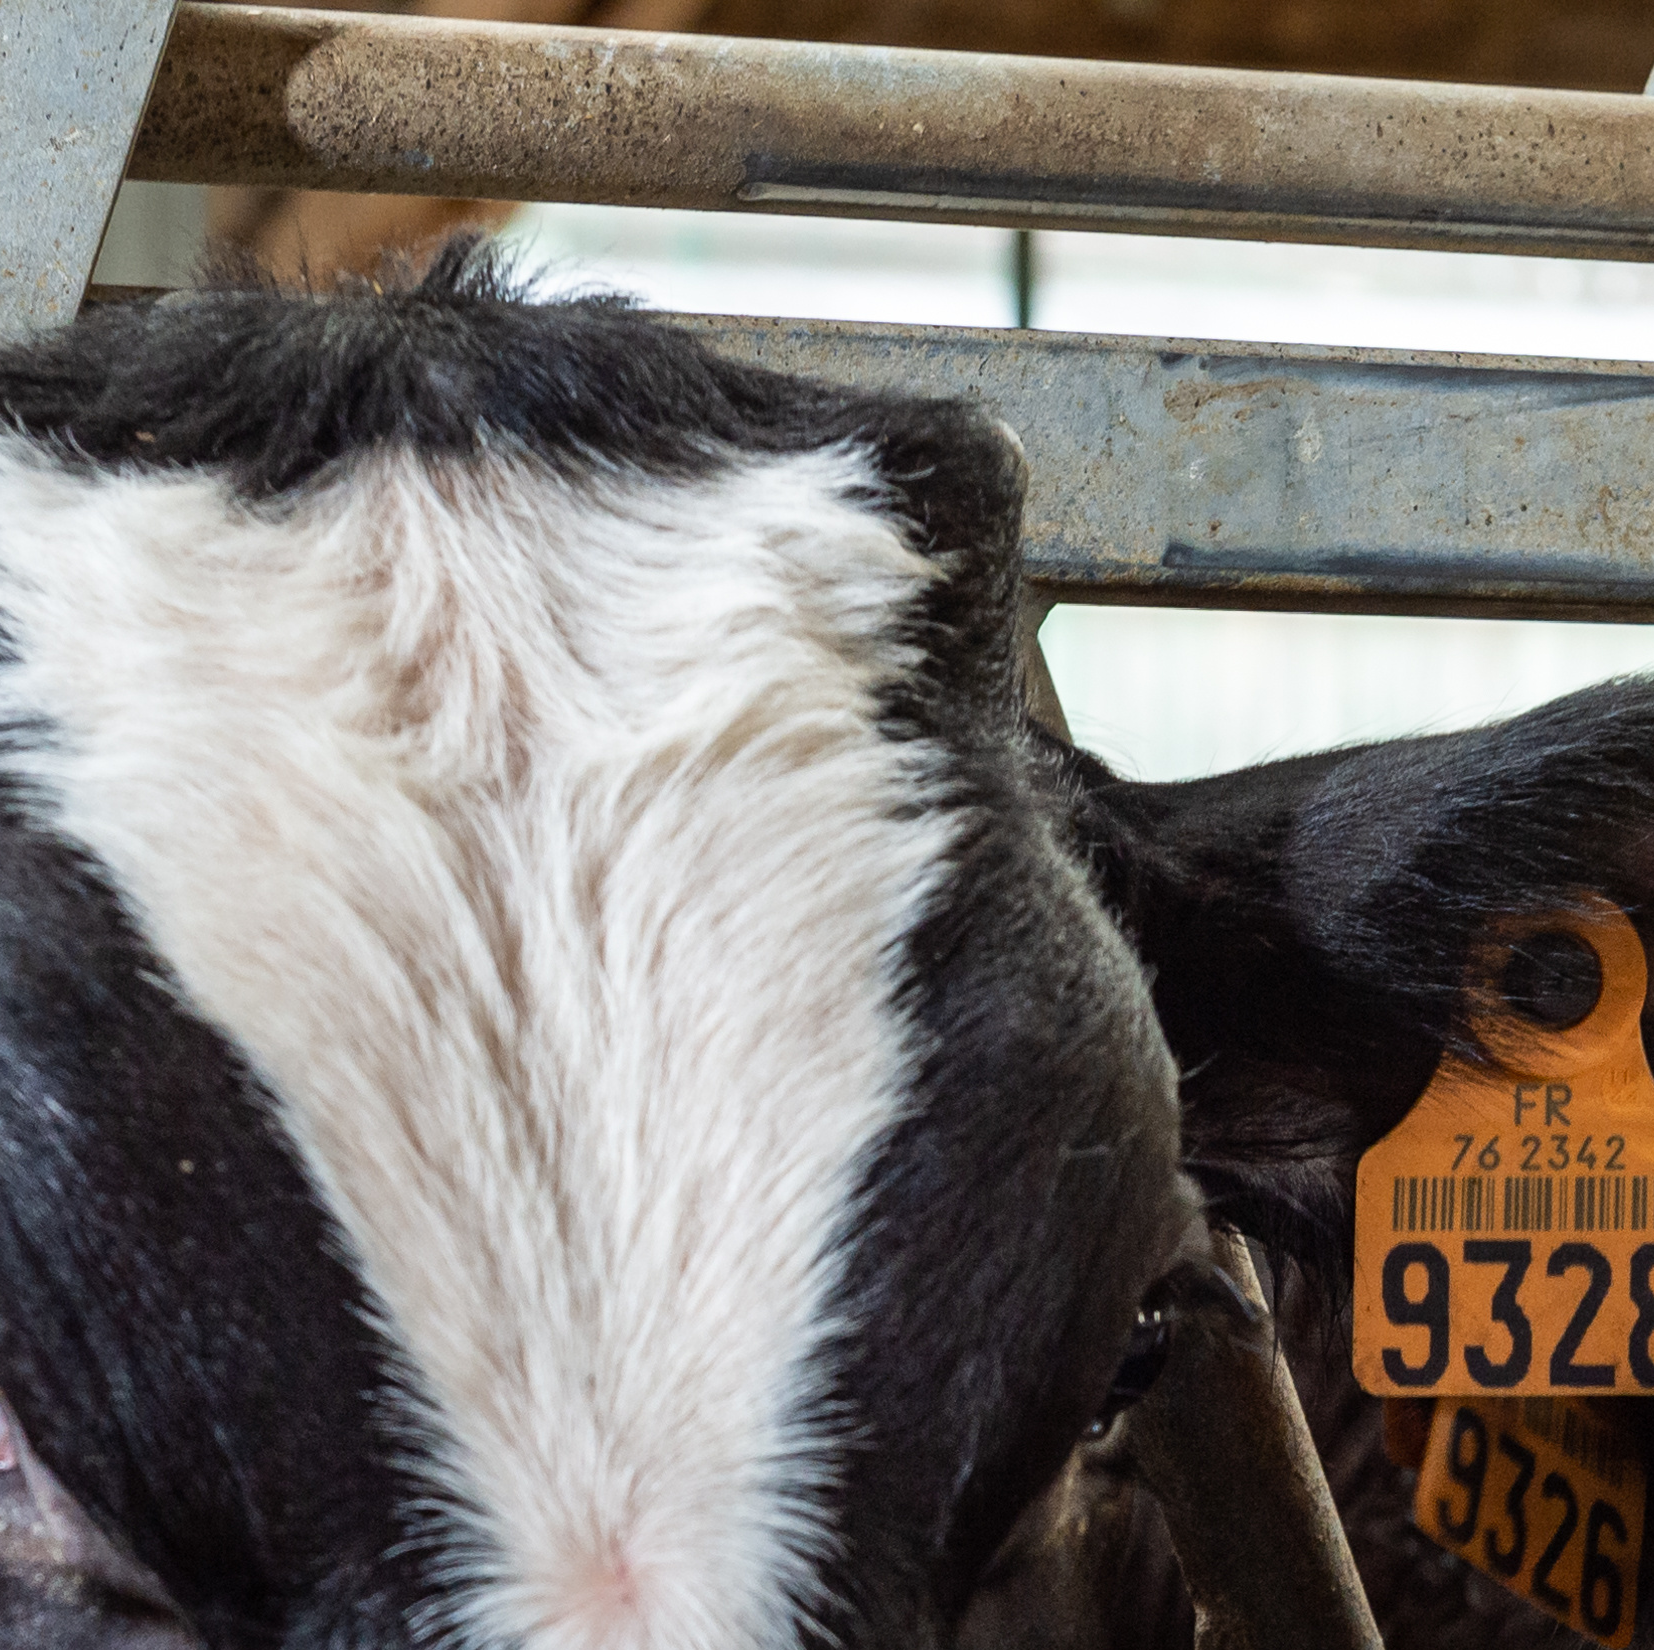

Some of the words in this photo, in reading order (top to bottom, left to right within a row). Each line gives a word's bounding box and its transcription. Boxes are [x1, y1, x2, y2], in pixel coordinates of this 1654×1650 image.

[1513, 1081, 1573, 1127] FR
[1451, 1133, 1502, 1172] 76
[1520, 1133, 1626, 1172] 2342
[1436, 1405, 1628, 1638] 9326
